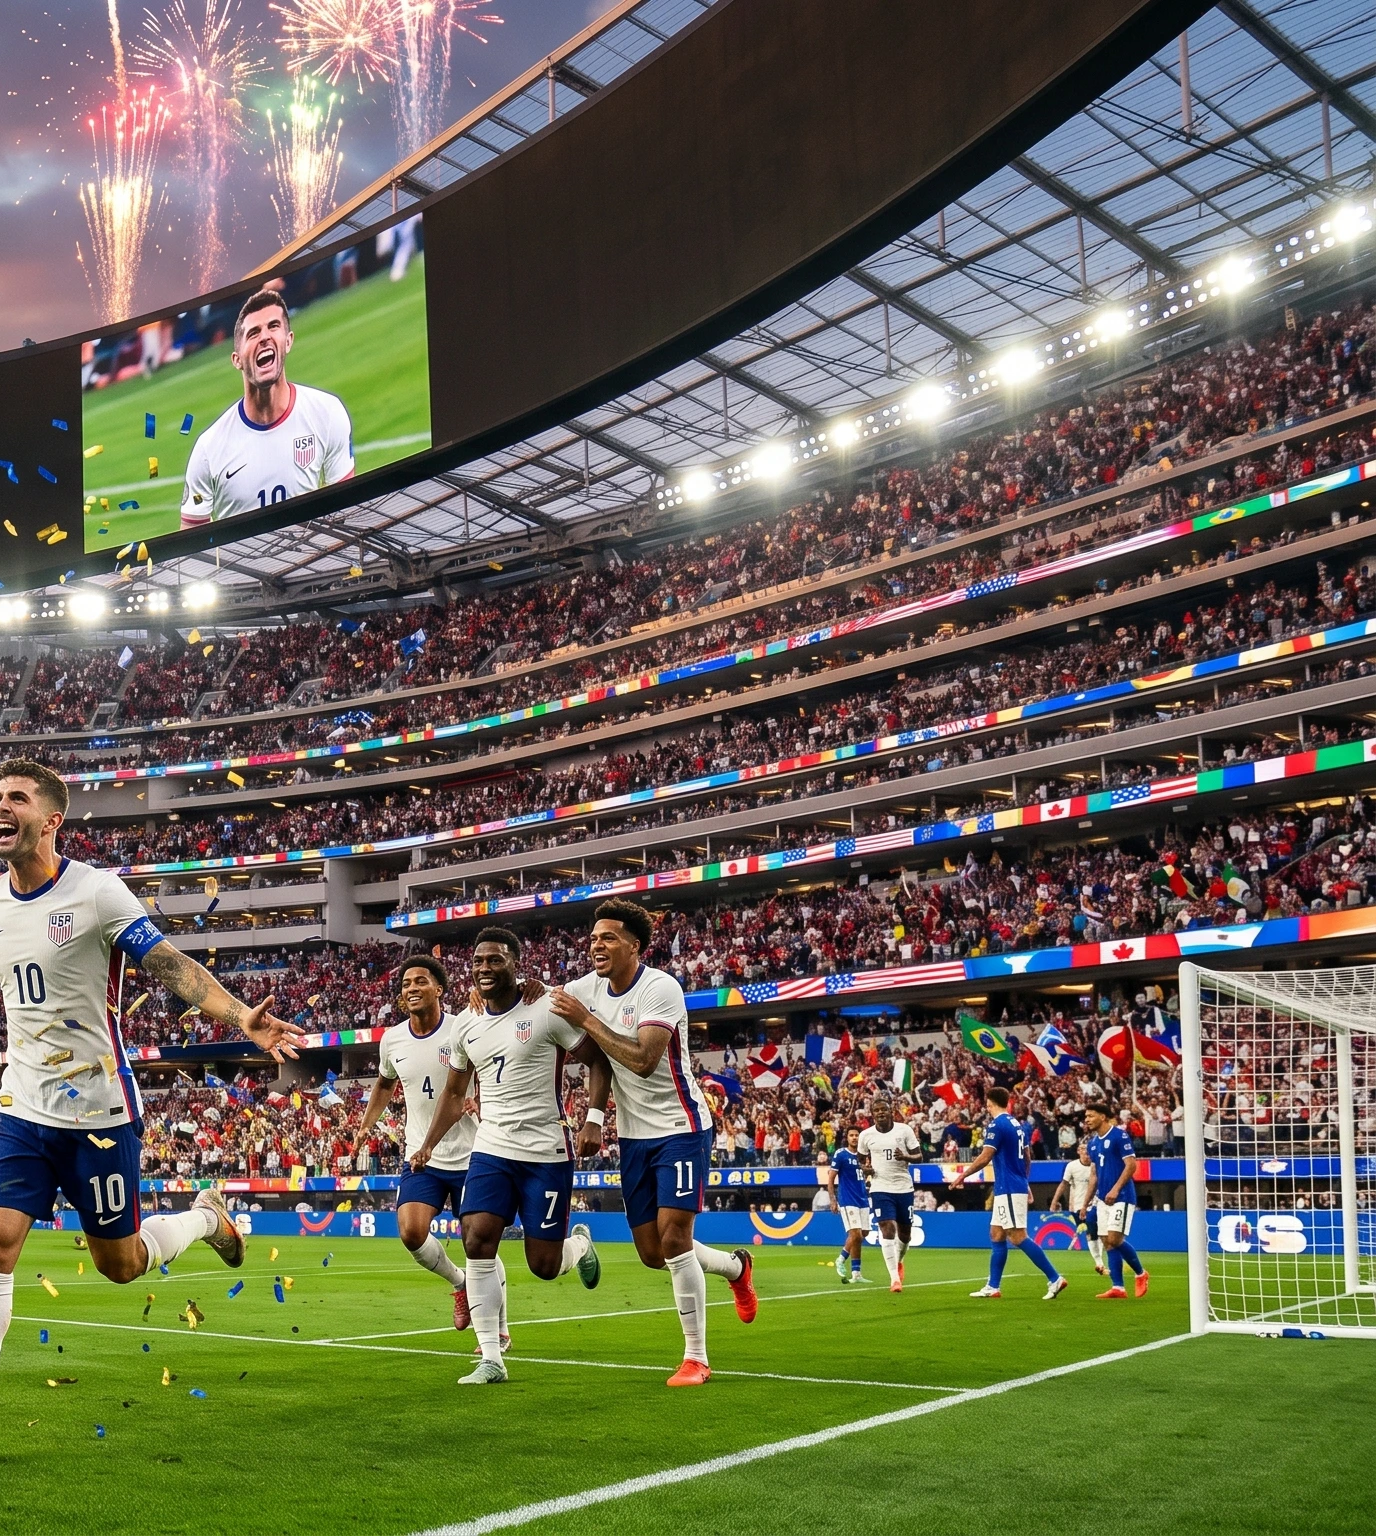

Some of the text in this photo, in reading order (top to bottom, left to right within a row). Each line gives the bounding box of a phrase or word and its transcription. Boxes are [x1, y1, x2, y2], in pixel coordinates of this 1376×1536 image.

[295, 437, 313, 450] USA
[13, 962, 47, 1005] 10
[492, 1055, 506, 1084] 7
[421, 1075, 435, 1100] 4
[674, 1160, 694, 1190] 11
[89, 1173, 126, 1213] 10
[544, 1190, 559, 1220] 7
